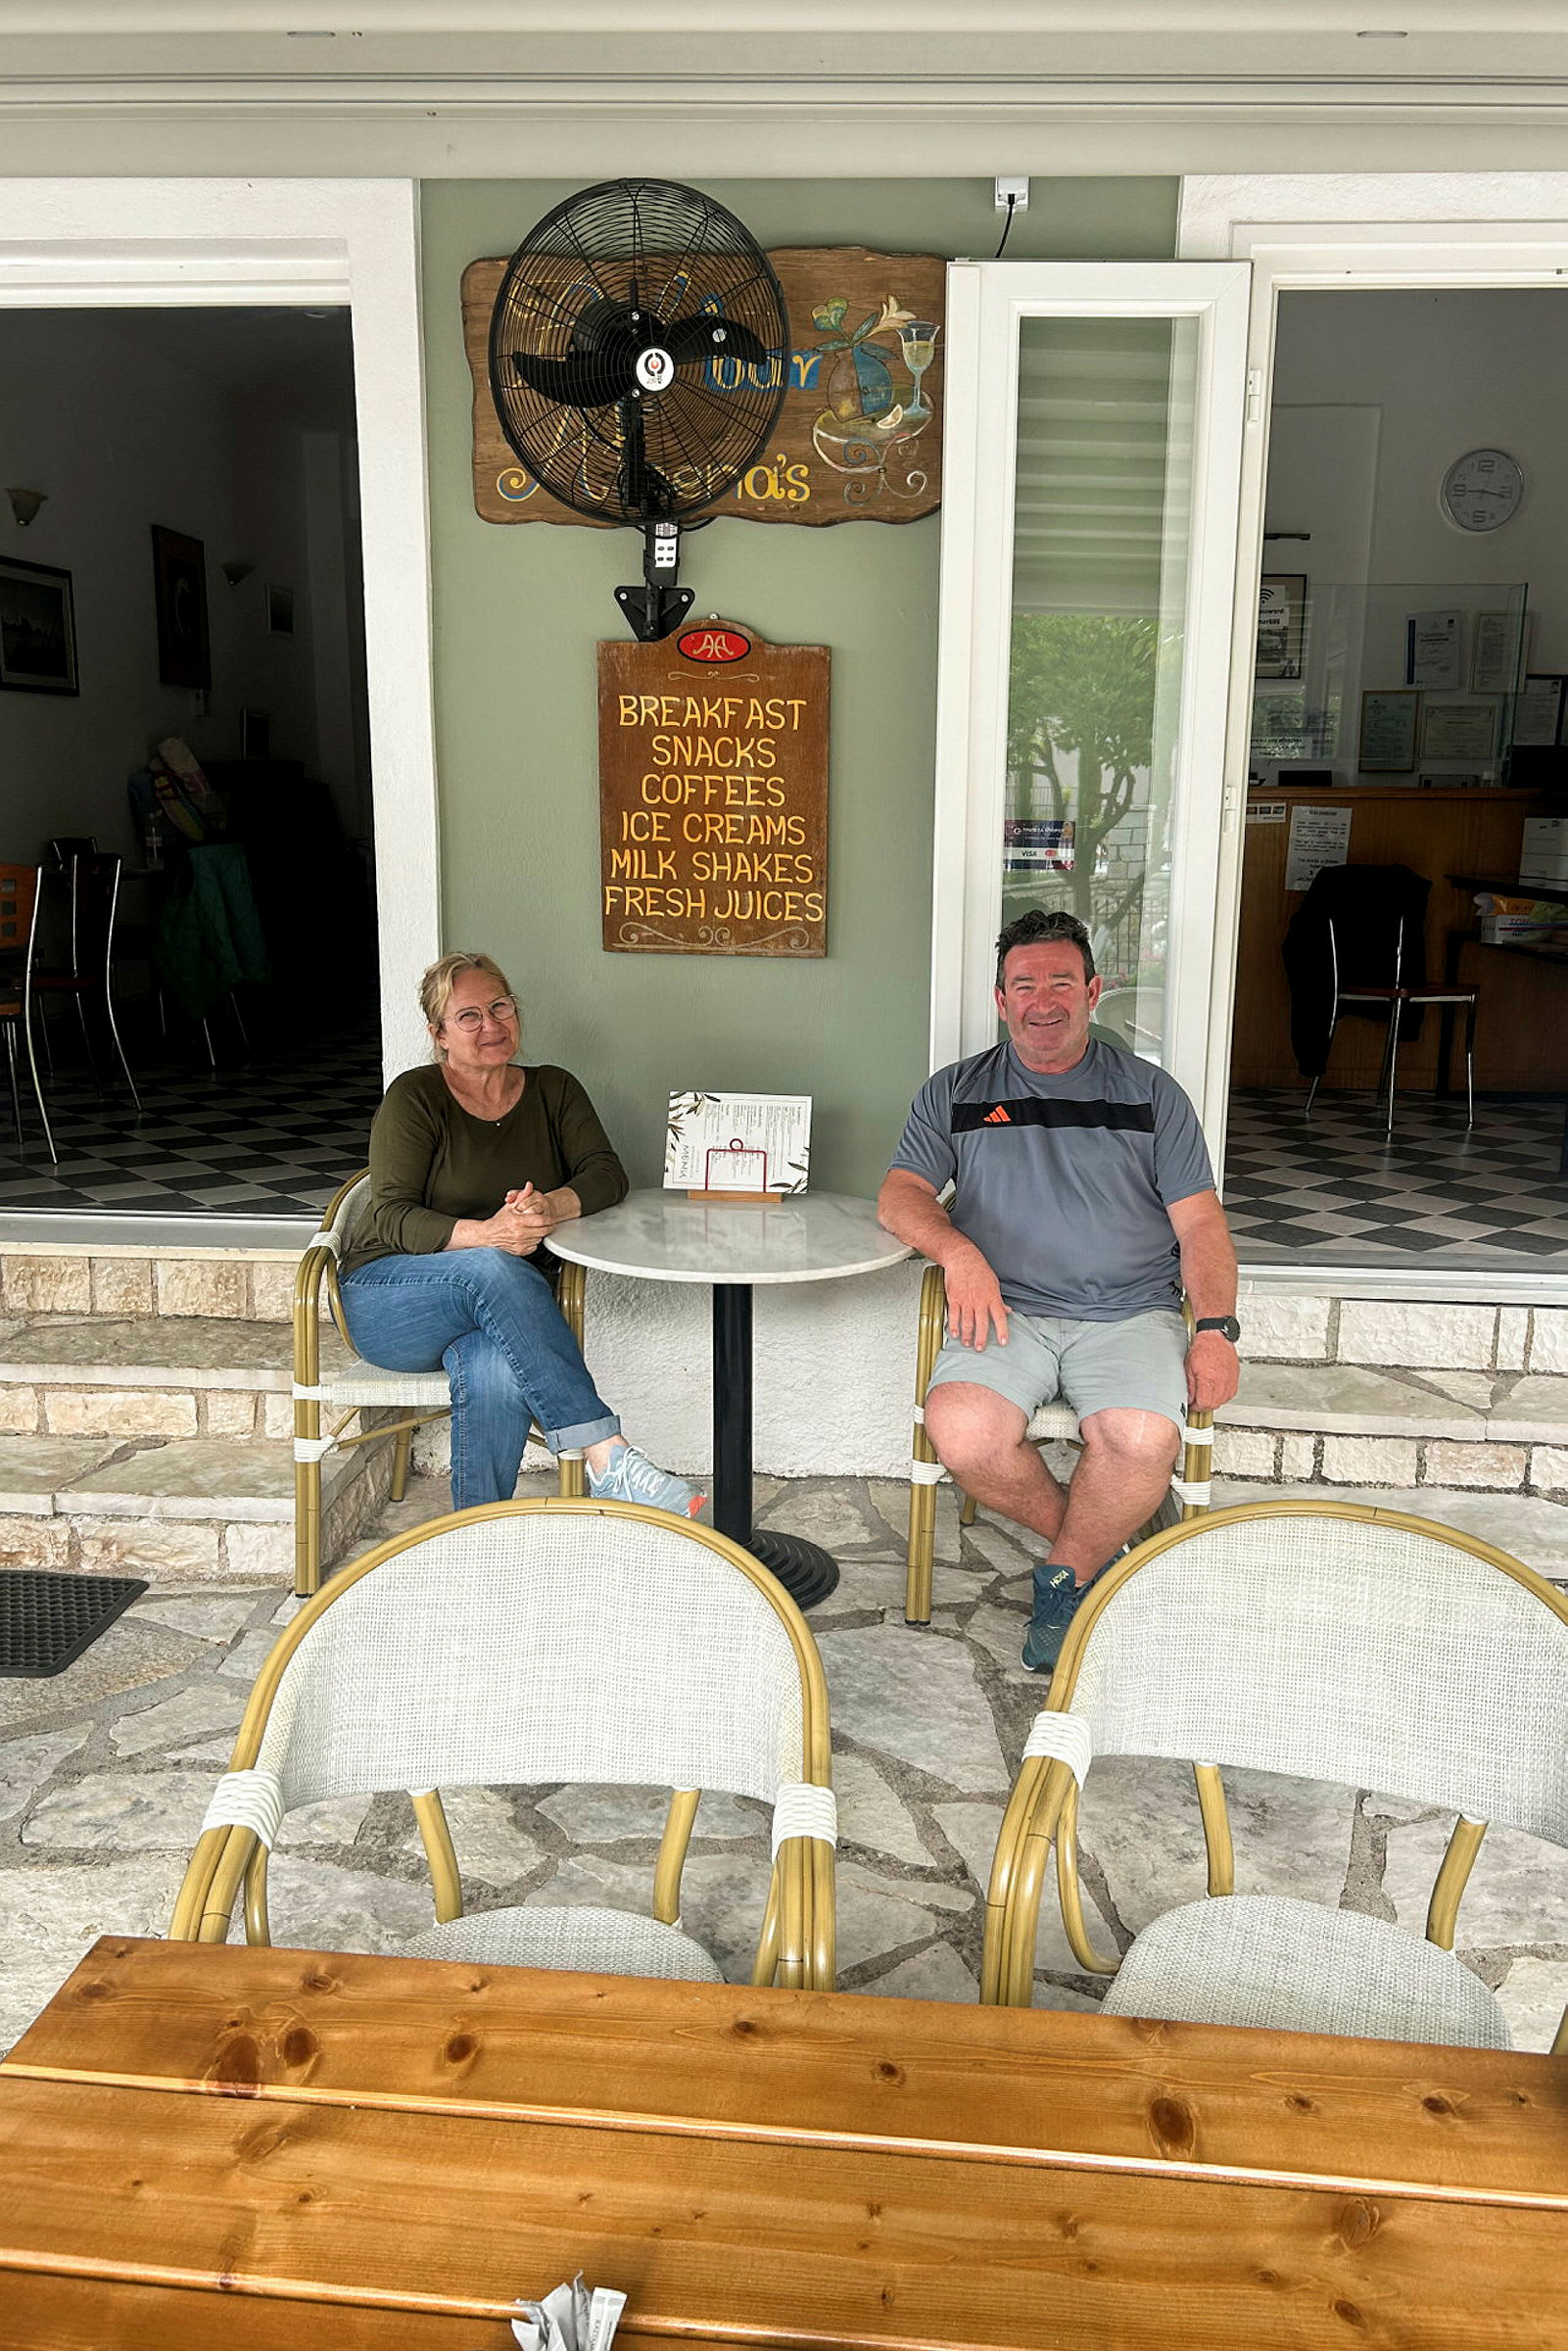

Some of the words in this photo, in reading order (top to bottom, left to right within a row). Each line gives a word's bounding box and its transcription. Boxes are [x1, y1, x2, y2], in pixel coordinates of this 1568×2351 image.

[619, 695, 807, 730] BREAKFAST
[651, 735, 777, 768] SNACKS
[641, 773, 785, 807] COFFEES
[621, 811, 671, 842] ICE
[683, 813, 806, 845] CREAMS
[610, 848, 678, 881] MILK
[692, 851, 813, 884] SHAKES
[605, 886, 705, 918] FRESH
[714, 889, 824, 922] JUICES
